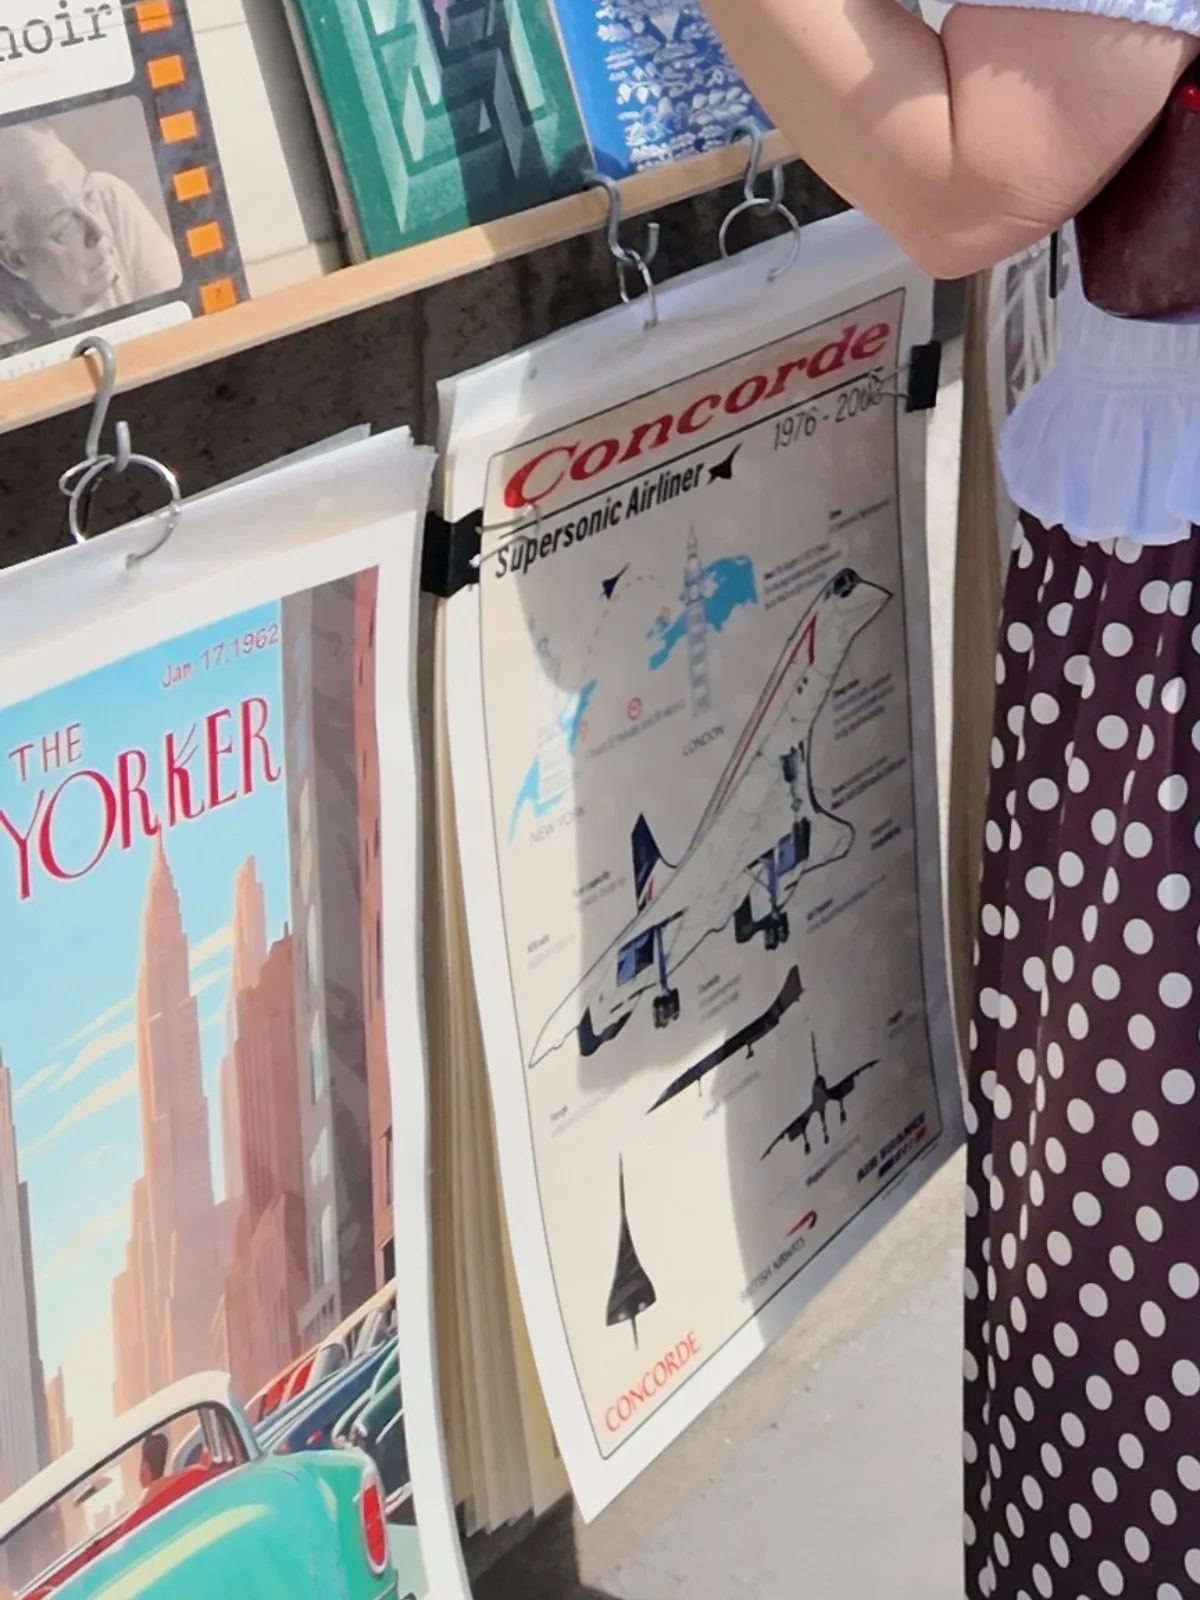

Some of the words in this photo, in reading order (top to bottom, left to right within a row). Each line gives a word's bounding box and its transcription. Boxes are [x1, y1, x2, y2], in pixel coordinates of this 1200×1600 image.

[503, 320, 892, 509] Concorde
[774, 406, 817, 451] 1976
[495, 498, 622, 580] Supersonic
[625, 460, 705, 521] Airliner
[162, 657, 192, 688] Jan
[8, 722, 83, 783] THE
[682, 723, 725, 757] LONDON
[0, 696, 282, 900] YORKER
[604, 1329, 702, 1433] CONCORDE
